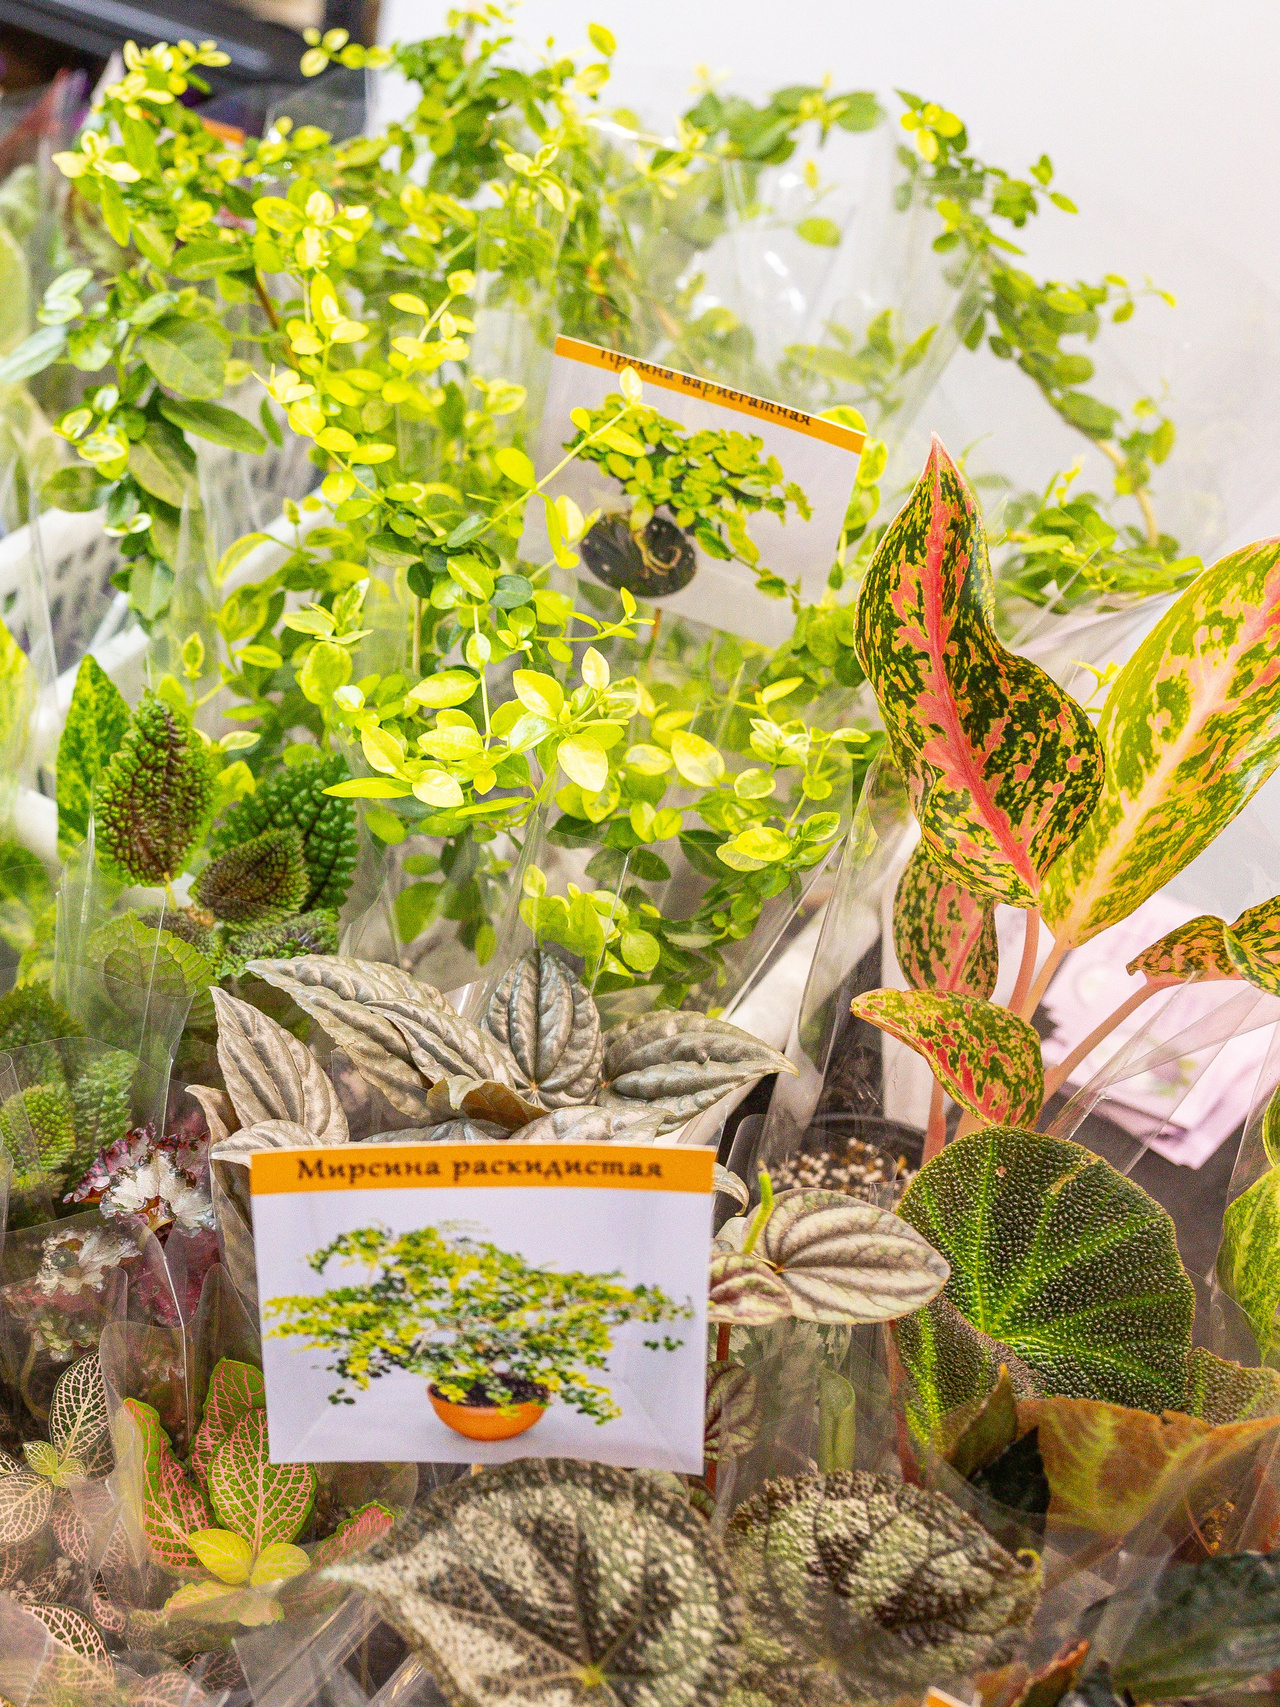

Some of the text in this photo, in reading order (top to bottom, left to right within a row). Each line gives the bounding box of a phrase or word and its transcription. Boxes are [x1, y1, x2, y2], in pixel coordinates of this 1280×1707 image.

[682, 374, 811, 426] вариегатная
[297, 1158, 663, 1184] Мирсина раскидистая
